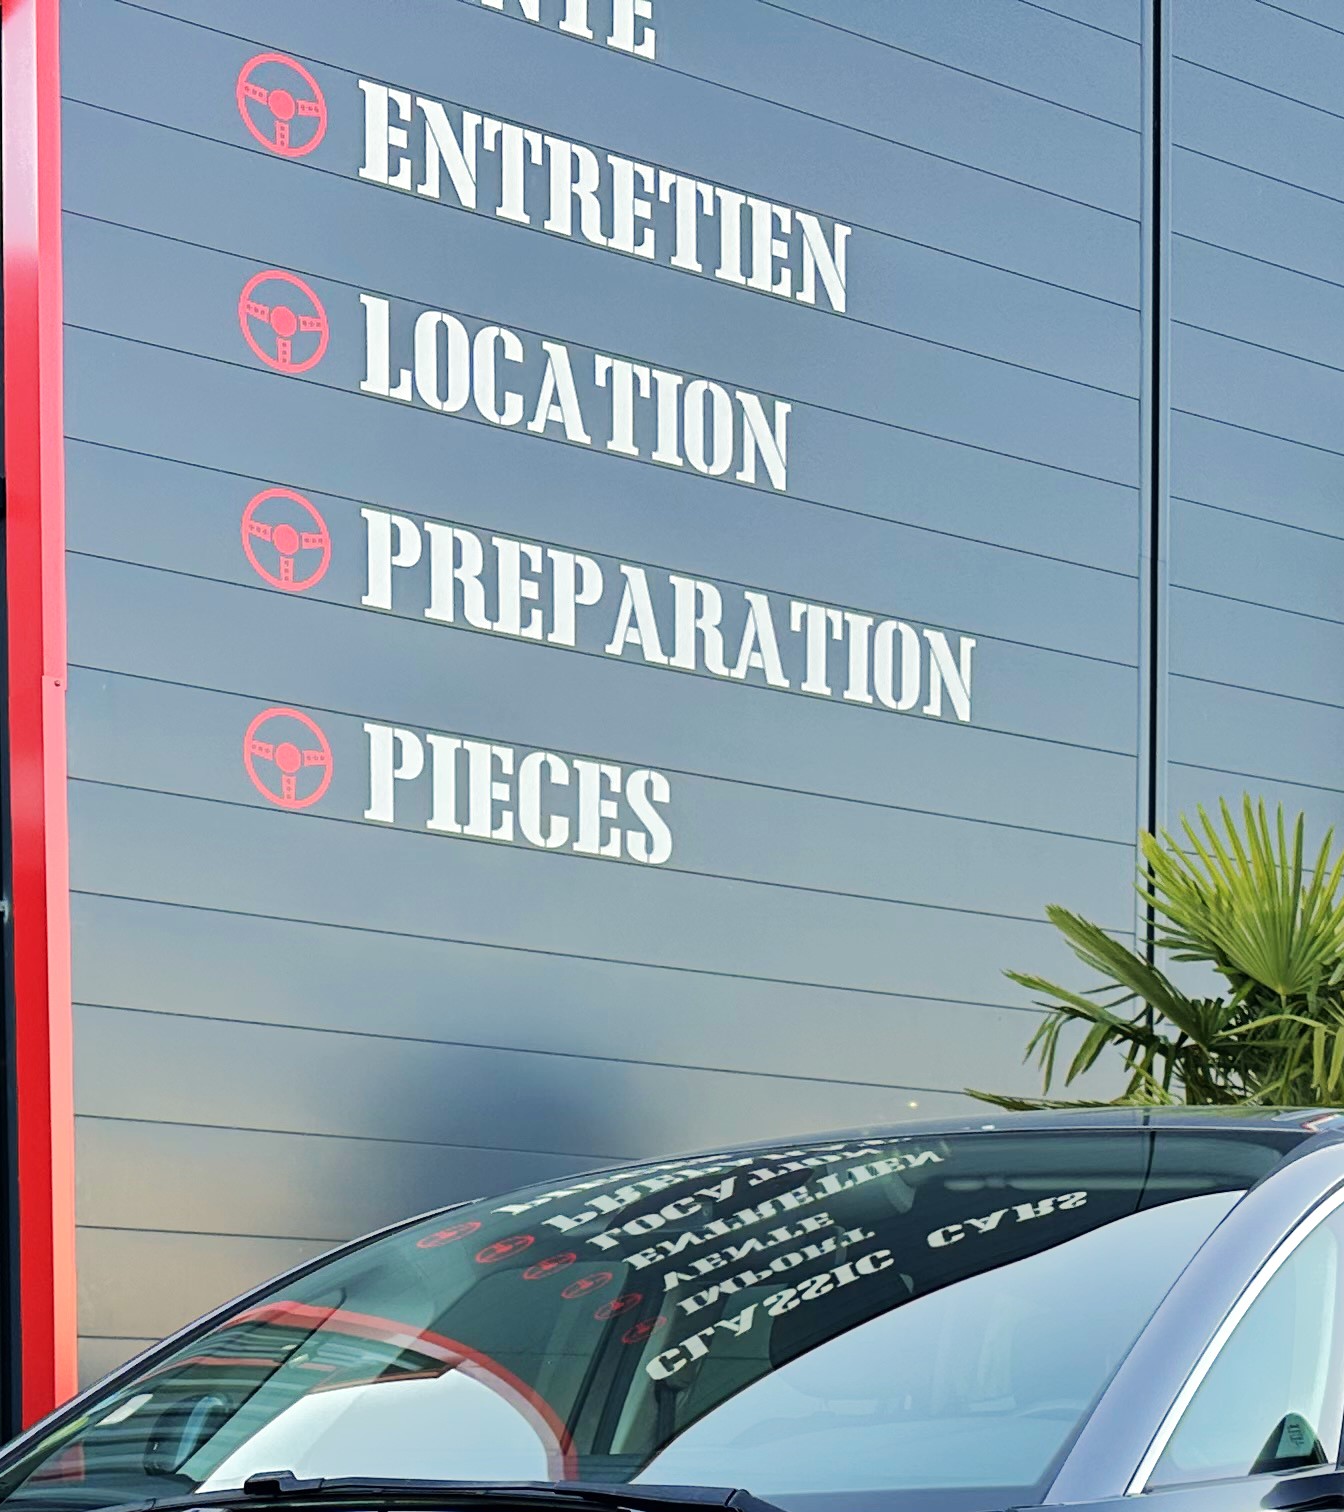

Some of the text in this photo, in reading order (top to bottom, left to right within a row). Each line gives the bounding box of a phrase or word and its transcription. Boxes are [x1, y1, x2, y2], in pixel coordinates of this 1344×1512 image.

[358, 79, 852, 313] ENTRETIEN
[359, 293, 792, 491] LOCATION
[361, 508, 976, 722] PREPARATION
[363, 722, 673, 864] PIECES
